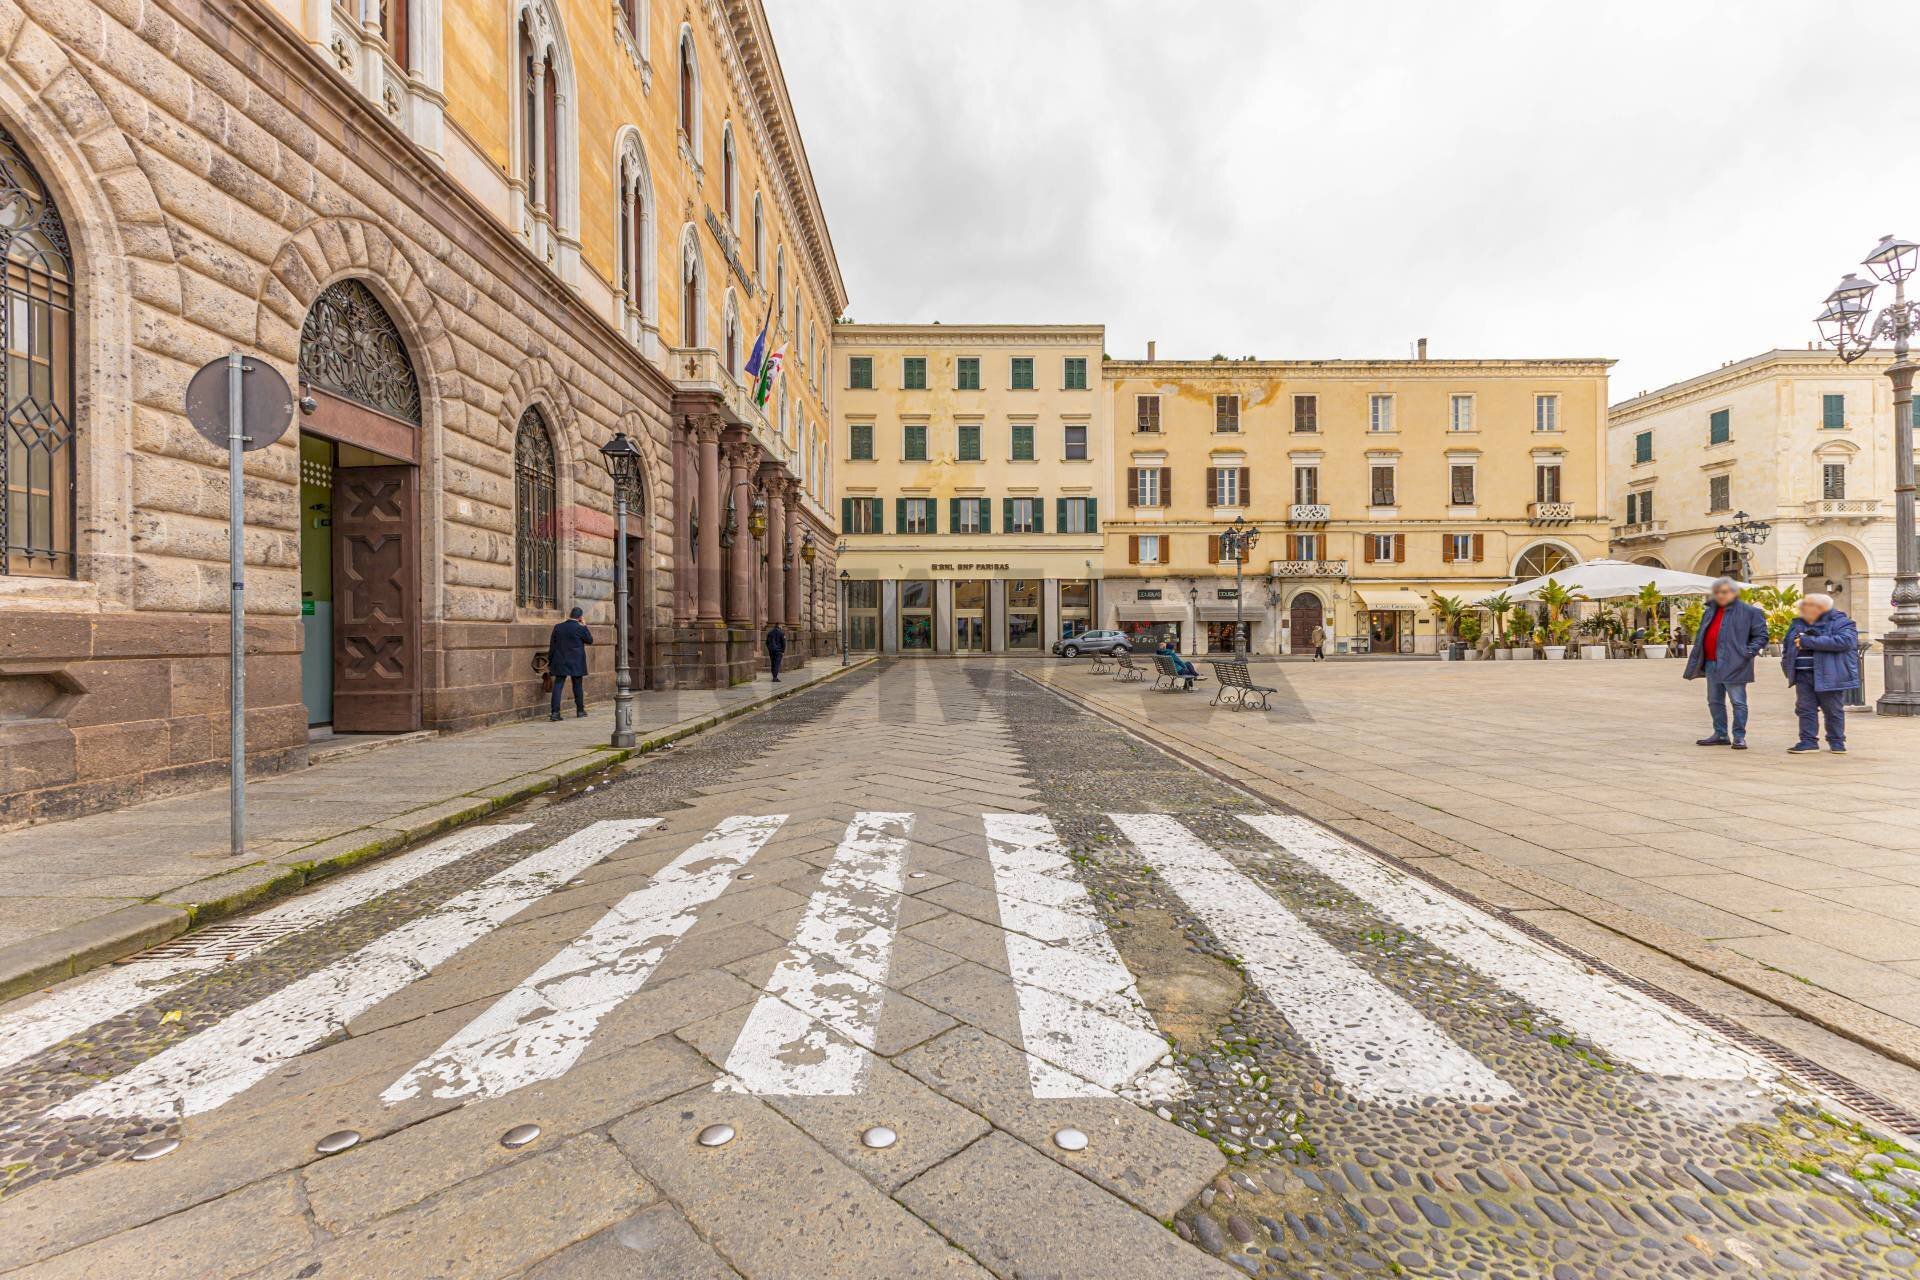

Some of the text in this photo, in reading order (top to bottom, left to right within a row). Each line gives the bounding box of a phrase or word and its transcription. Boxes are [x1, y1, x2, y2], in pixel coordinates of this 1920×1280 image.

[939, 563, 1010, 571] BNL BNP PARIBAS
